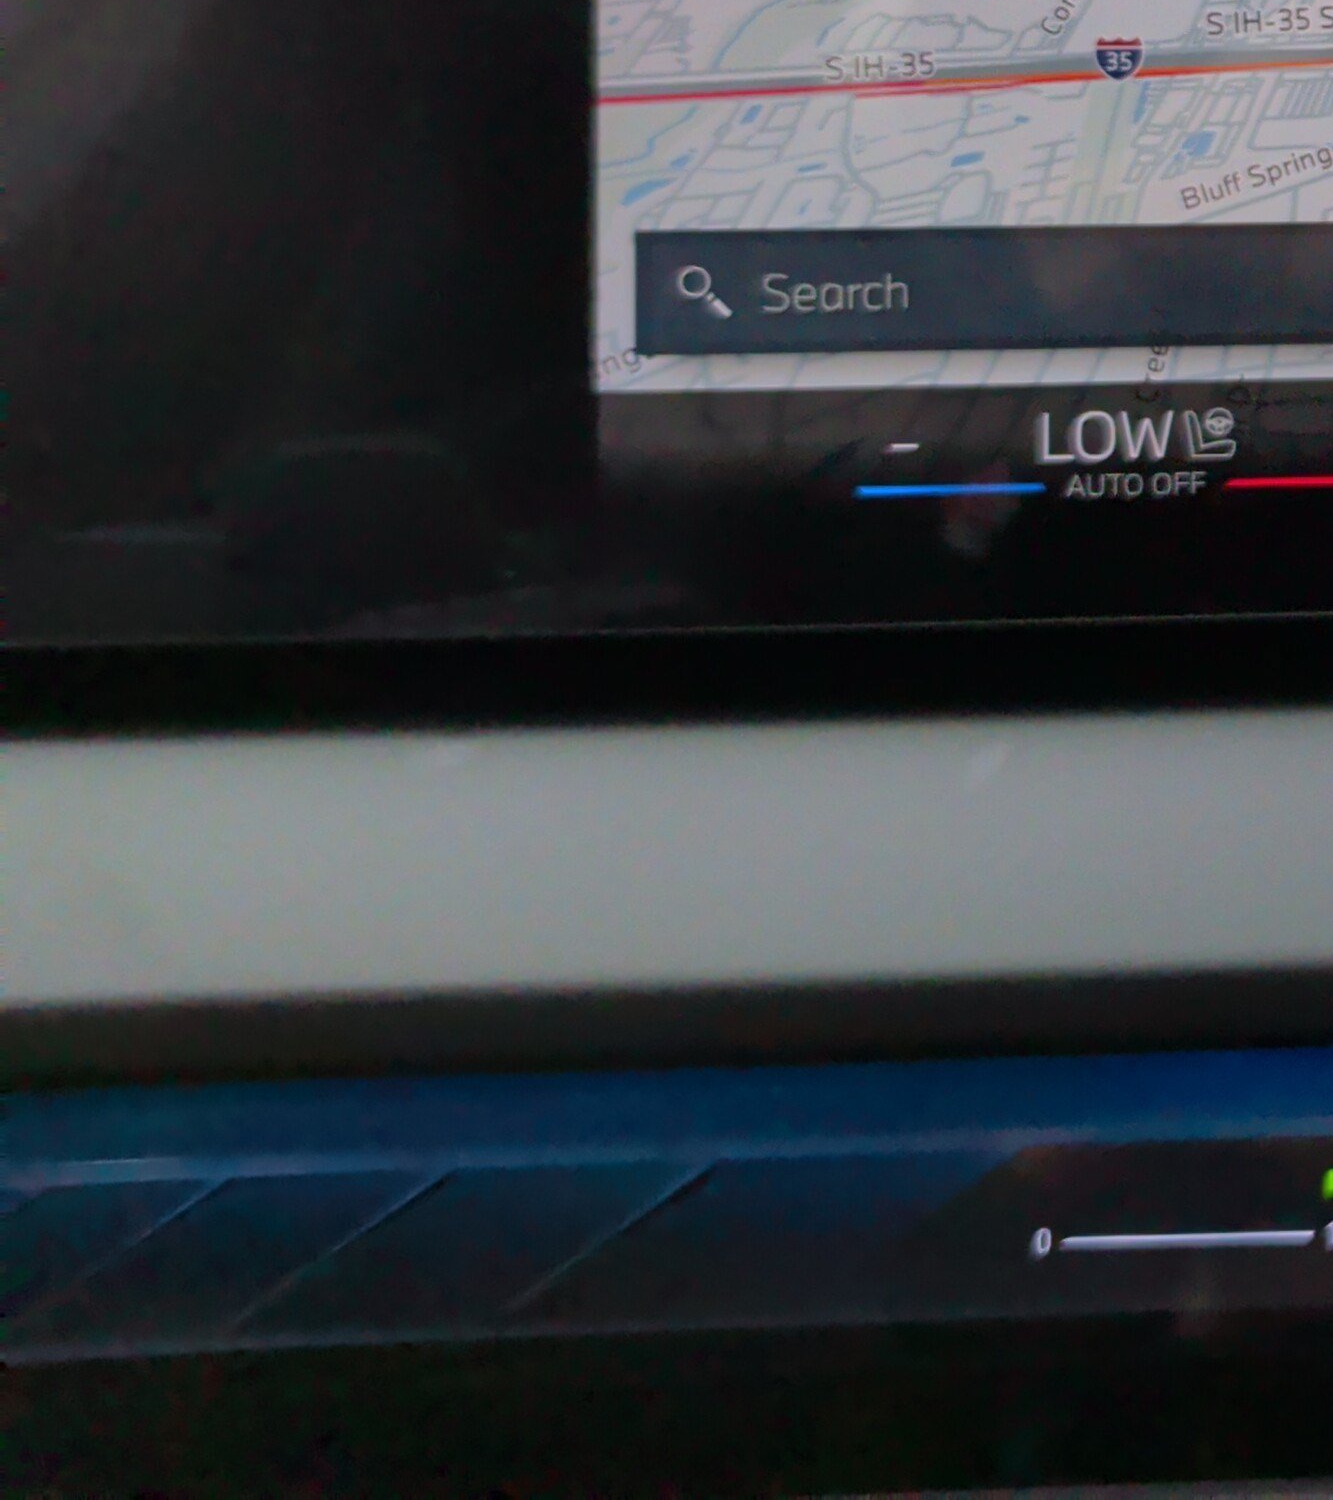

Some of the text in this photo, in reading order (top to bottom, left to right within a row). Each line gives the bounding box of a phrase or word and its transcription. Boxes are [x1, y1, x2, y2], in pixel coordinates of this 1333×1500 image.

[1207, 13, 1224, 35] S
[1234, 8, 1310, 34] IH-35
[825, 52, 936, 79] S IH-35
[1105, 52, 1132, 71] 35
[1181, 171, 1242, 210] Bluff
[761, 273, 909, 314] Search
[1034, 410, 1174, 464] LOW
[1066, 471, 1206, 499] AUTO OFF
